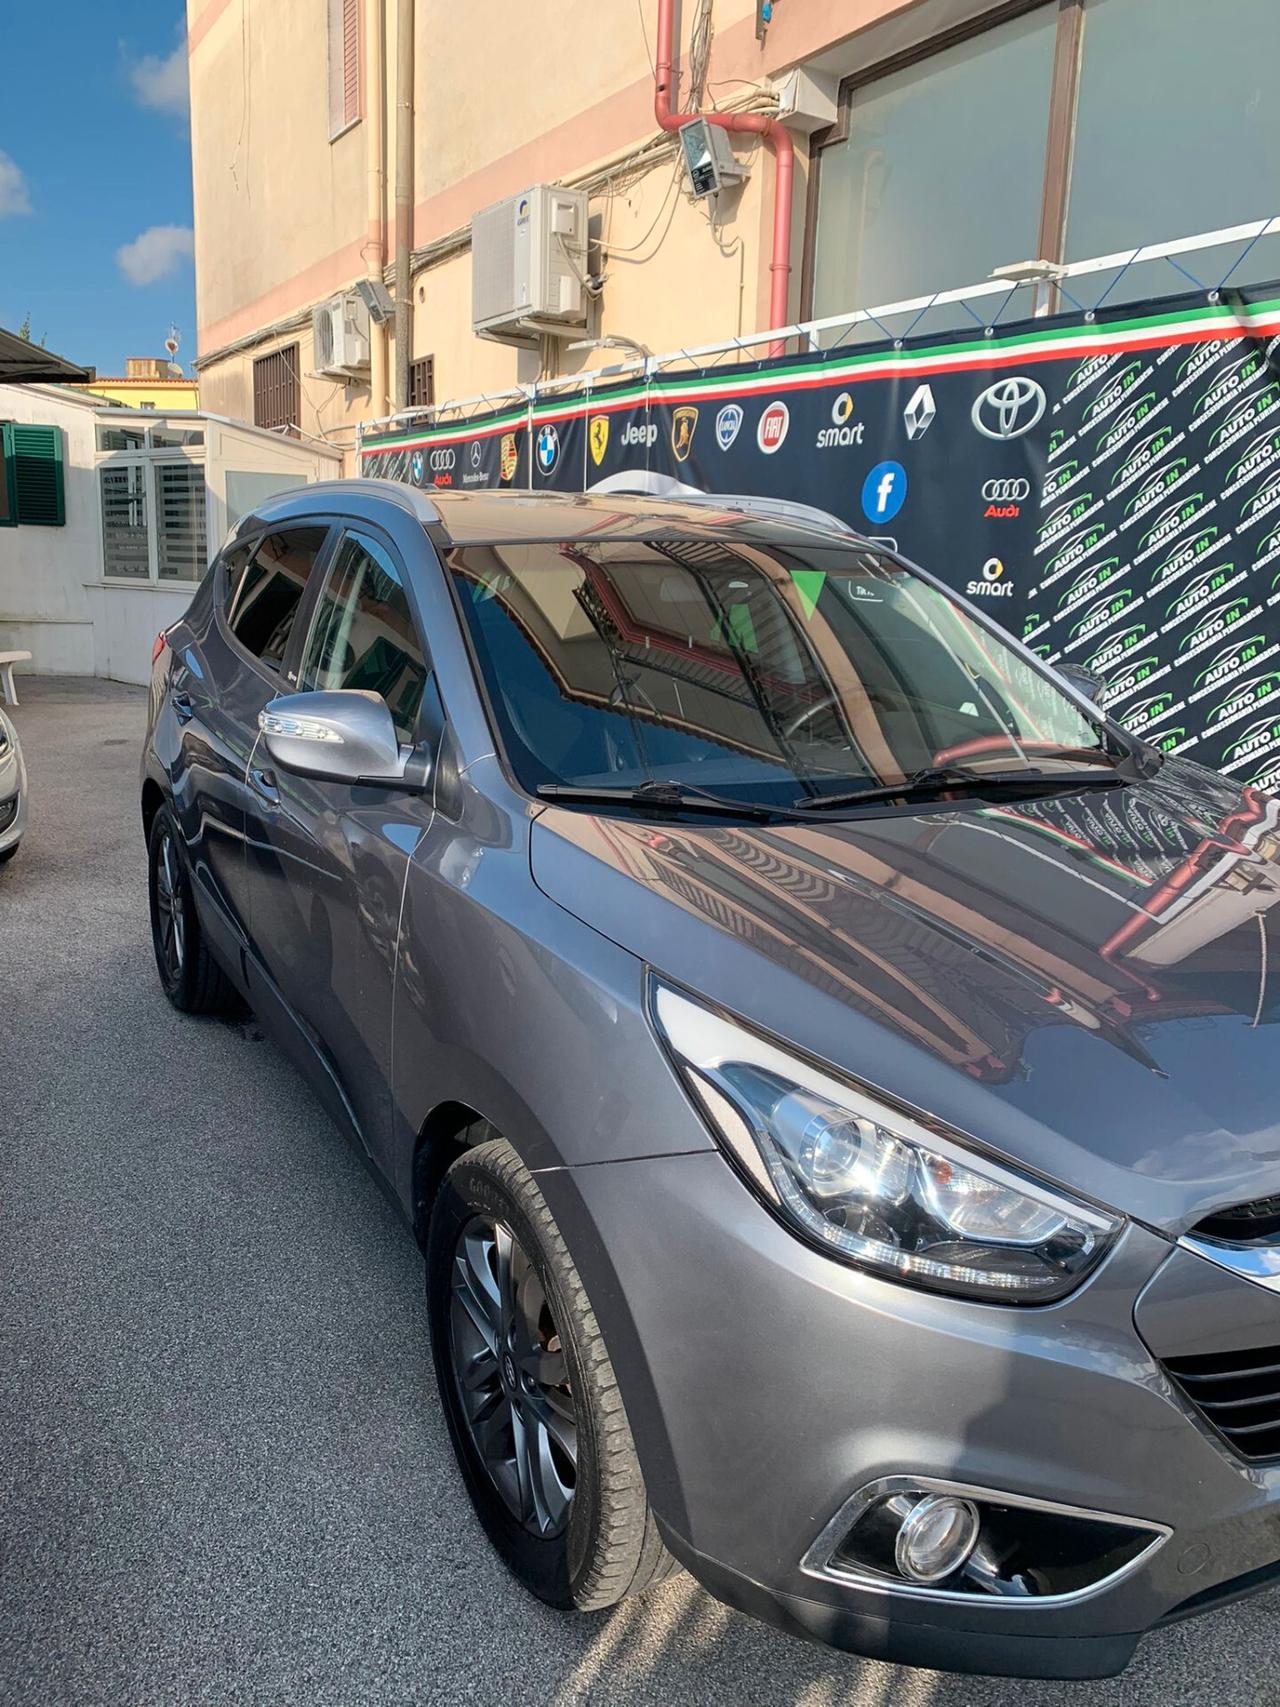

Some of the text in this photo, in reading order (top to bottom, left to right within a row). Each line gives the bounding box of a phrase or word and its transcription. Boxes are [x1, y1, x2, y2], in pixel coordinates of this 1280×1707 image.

[1076, 354, 1108, 384] AUTO
[1187, 340, 1221, 375] AUTO
[1092, 372, 1135, 417] AUTO IN
[1204, 361, 1257, 411] AUTO IN
[621, 422, 657, 447] Jeep
[765, 416, 783, 438] FIAT
[816, 422, 864, 448] smart
[1106, 403, 1149, 448] AUTO IN
[1220, 394, 1273, 443] AUTO IN
[1058, 470, 1071, 484] IN
[1121, 437, 1165, 481] AUTO IN
[1237, 445, 1272, 479] AUTO
[434, 474, 451, 485] Audi
[1134, 468, 1179, 512] AUTO IN
[984, 505, 1019, 517] Audi
[1041, 503, 1085, 541] AUTO IN
[1148, 504, 1195, 546] AUTO IN
[1055, 533, 1097, 571] AUTO IN
[1161, 538, 1209, 579] AUTO IN
[966, 581, 1014, 597] smart
[1067, 567, 1111, 604] AUTO IN
[1176, 574, 1225, 615] AUTO IN
[1078, 599, 1124, 636] AUTO IN
[1190, 608, 1240, 649] AUTO IN
[1091, 633, 1137, 670] AUTO IN
[1205, 646, 1257, 686] AUTO IN
[1102, 666, 1150, 702] AUTO IN
[1218, 682, 1272, 721] AUTO IN
[1150, 702, 1164, 717] IN
[1162, 737, 1176, 752] IN
[1234, 731, 1271, 760] AUTO
